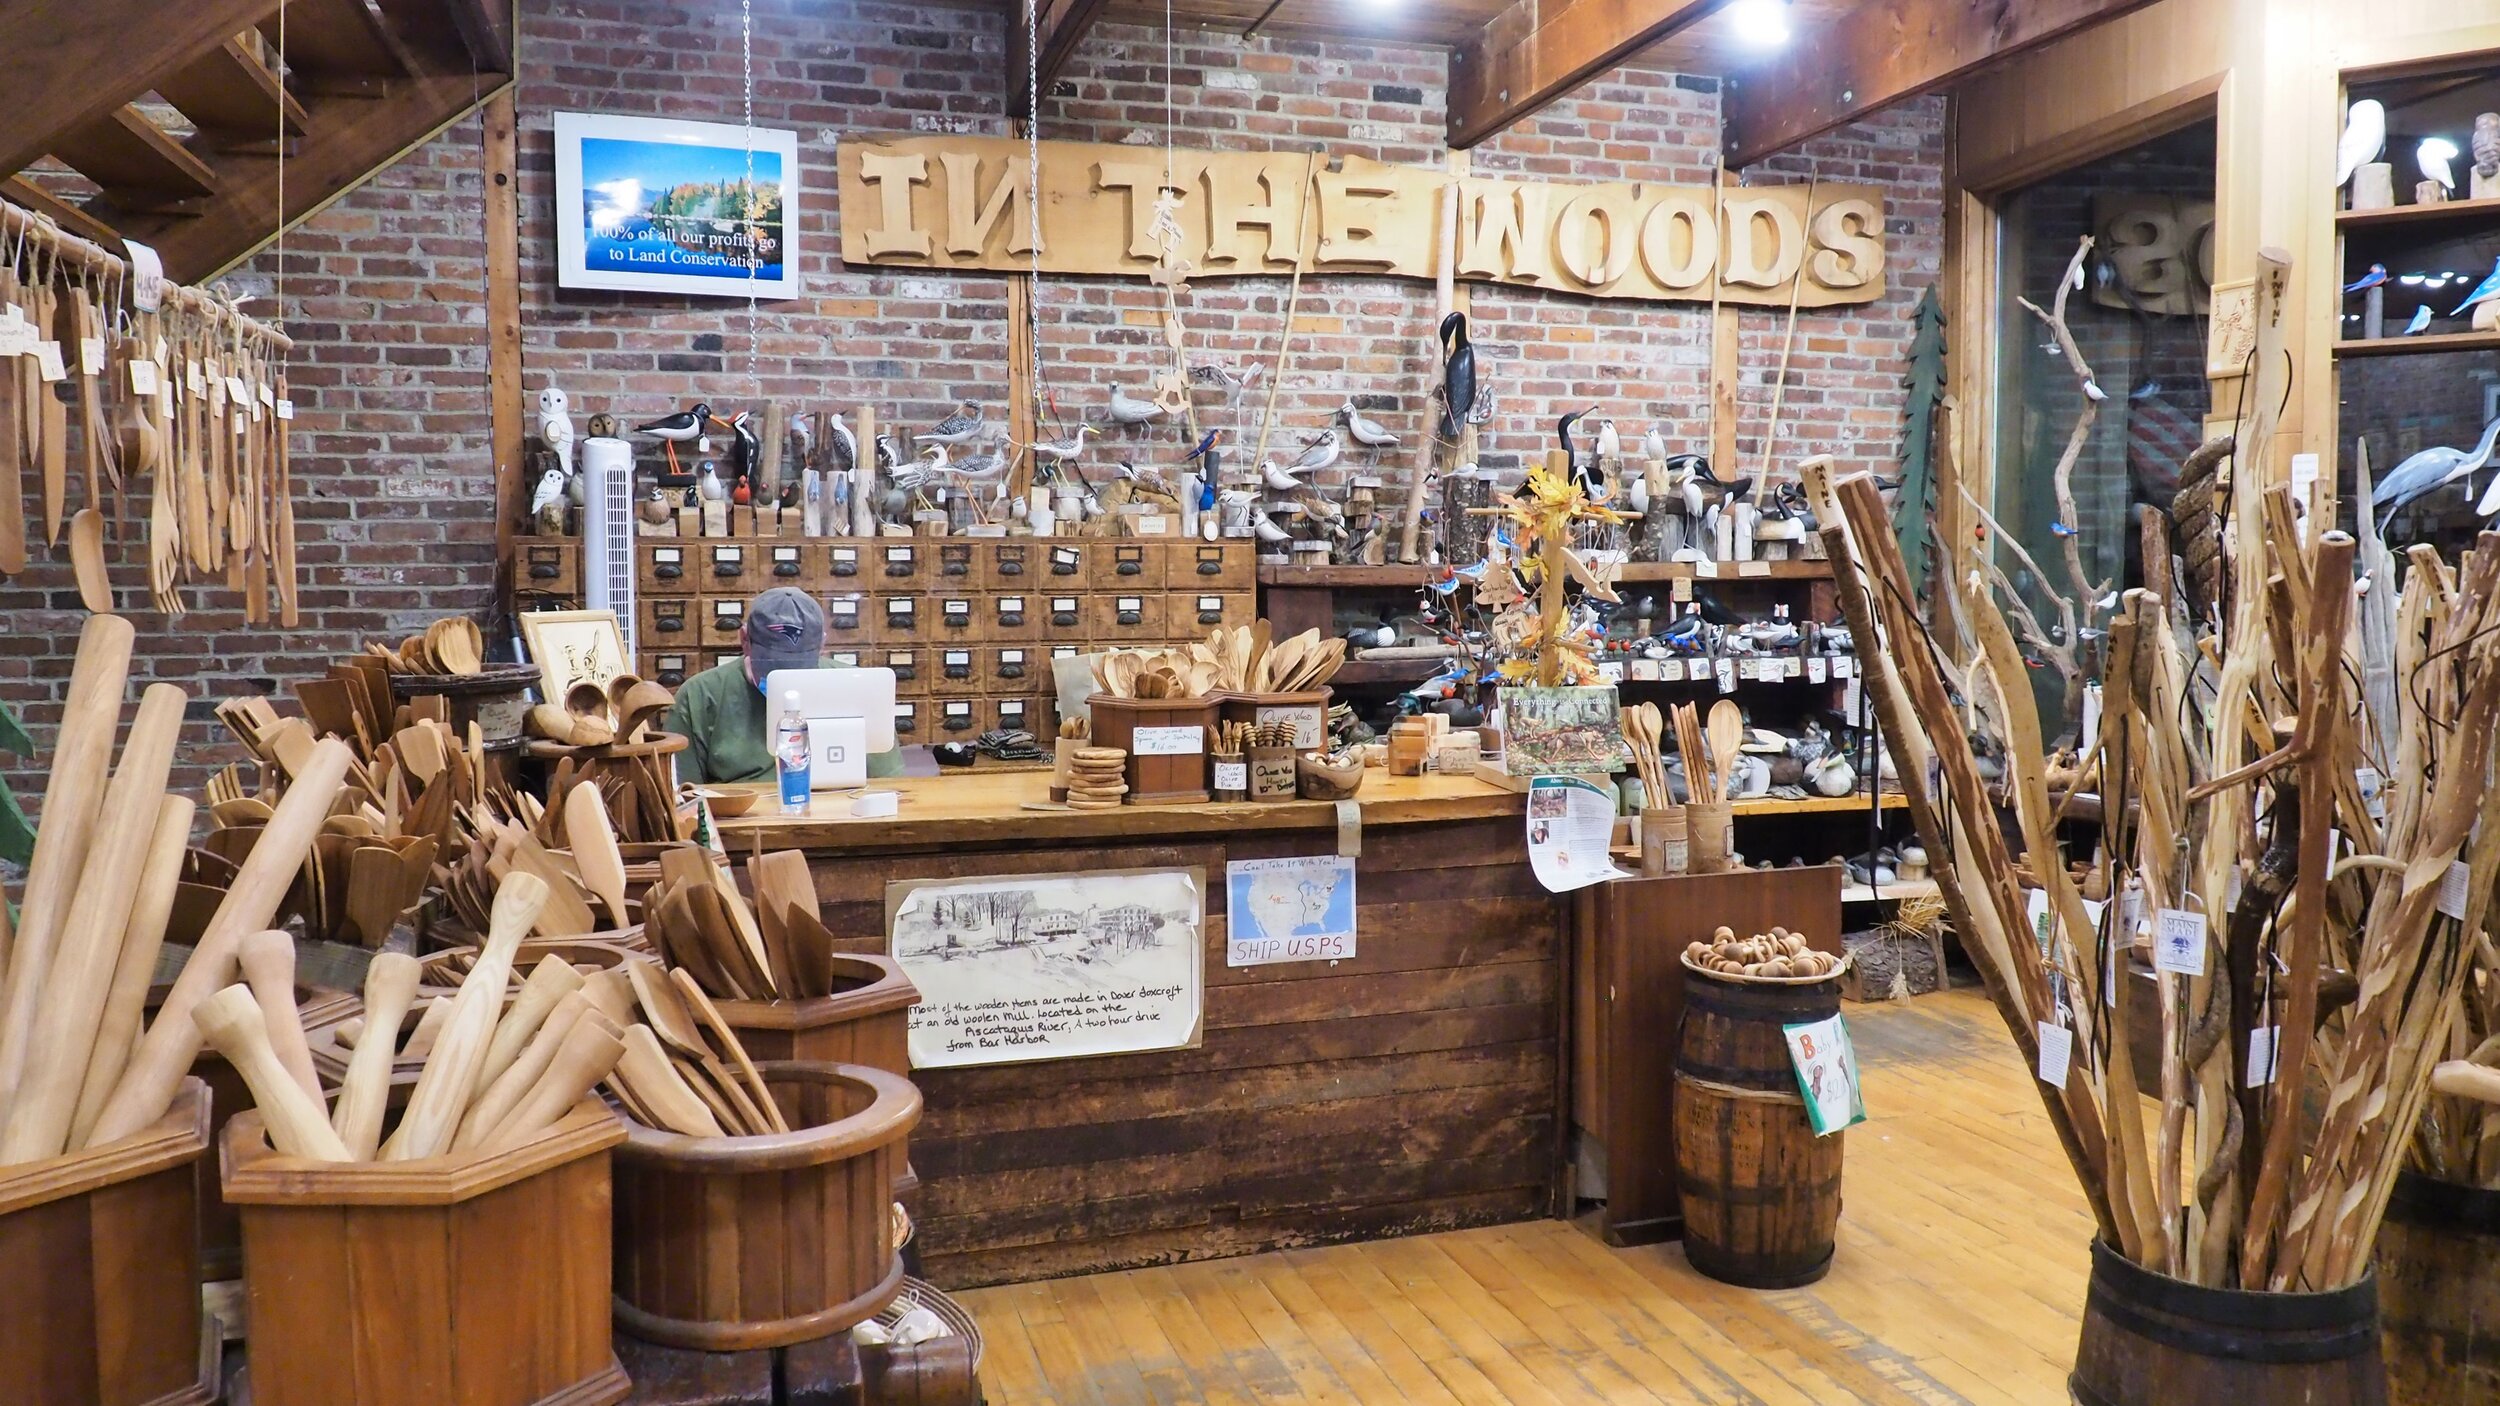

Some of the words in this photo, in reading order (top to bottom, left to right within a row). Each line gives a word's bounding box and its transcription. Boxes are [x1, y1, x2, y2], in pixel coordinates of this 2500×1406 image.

[1092, 160, 1398, 273] THE
[1457, 184, 1887, 289] WOODS
[592, 225, 635, 241] 100%
[638, 227, 657, 242] of
[657, 228, 676, 242] all
[680, 232, 704, 244] our
[708, 231, 755, 249] profits
[758, 235, 776, 251] go
[609, 247, 624, 261] to
[628, 247, 666, 263] Land
[670, 250, 764, 269] Conservation
[1513, 697, 1557, 707] Everything
[1568, 697, 1608, 705] Connected
[1136, 728, 1157, 736] Olive
[1268, 860, 1284, 869] Take
[2165, 918, 2199, 930] MAINE
[2166, 926, 2199, 937] MADE
[1234, 939, 1281, 961] SHIP
[941, 1002, 952, 1017] of
[953, 1002, 972, 1012] the
[974, 998, 1009, 1011] wooden
[1042, 997, 1061, 1005] are
[1063, 992, 1095, 1004] made
[1096, 989, 1107, 1002] in
[1110, 989, 1136, 1001] Dover
[926, 1020, 939, 1028] an
[944, 1014, 960, 1026] old
[963, 1013, 1000, 1025] woolen
[1085, 1007, 1099, 1015] on
[1101, 1003, 1127, 1013] the
[1085, 1017, 1107, 1028] two
[1107, 1014, 1134, 1027] hour
[1135, 1009, 1161, 1022] drive
[946, 1039, 974, 1053] from
[979, 1038, 1000, 1049] Bar
[1799, 1033, 1833, 1061] Baby
